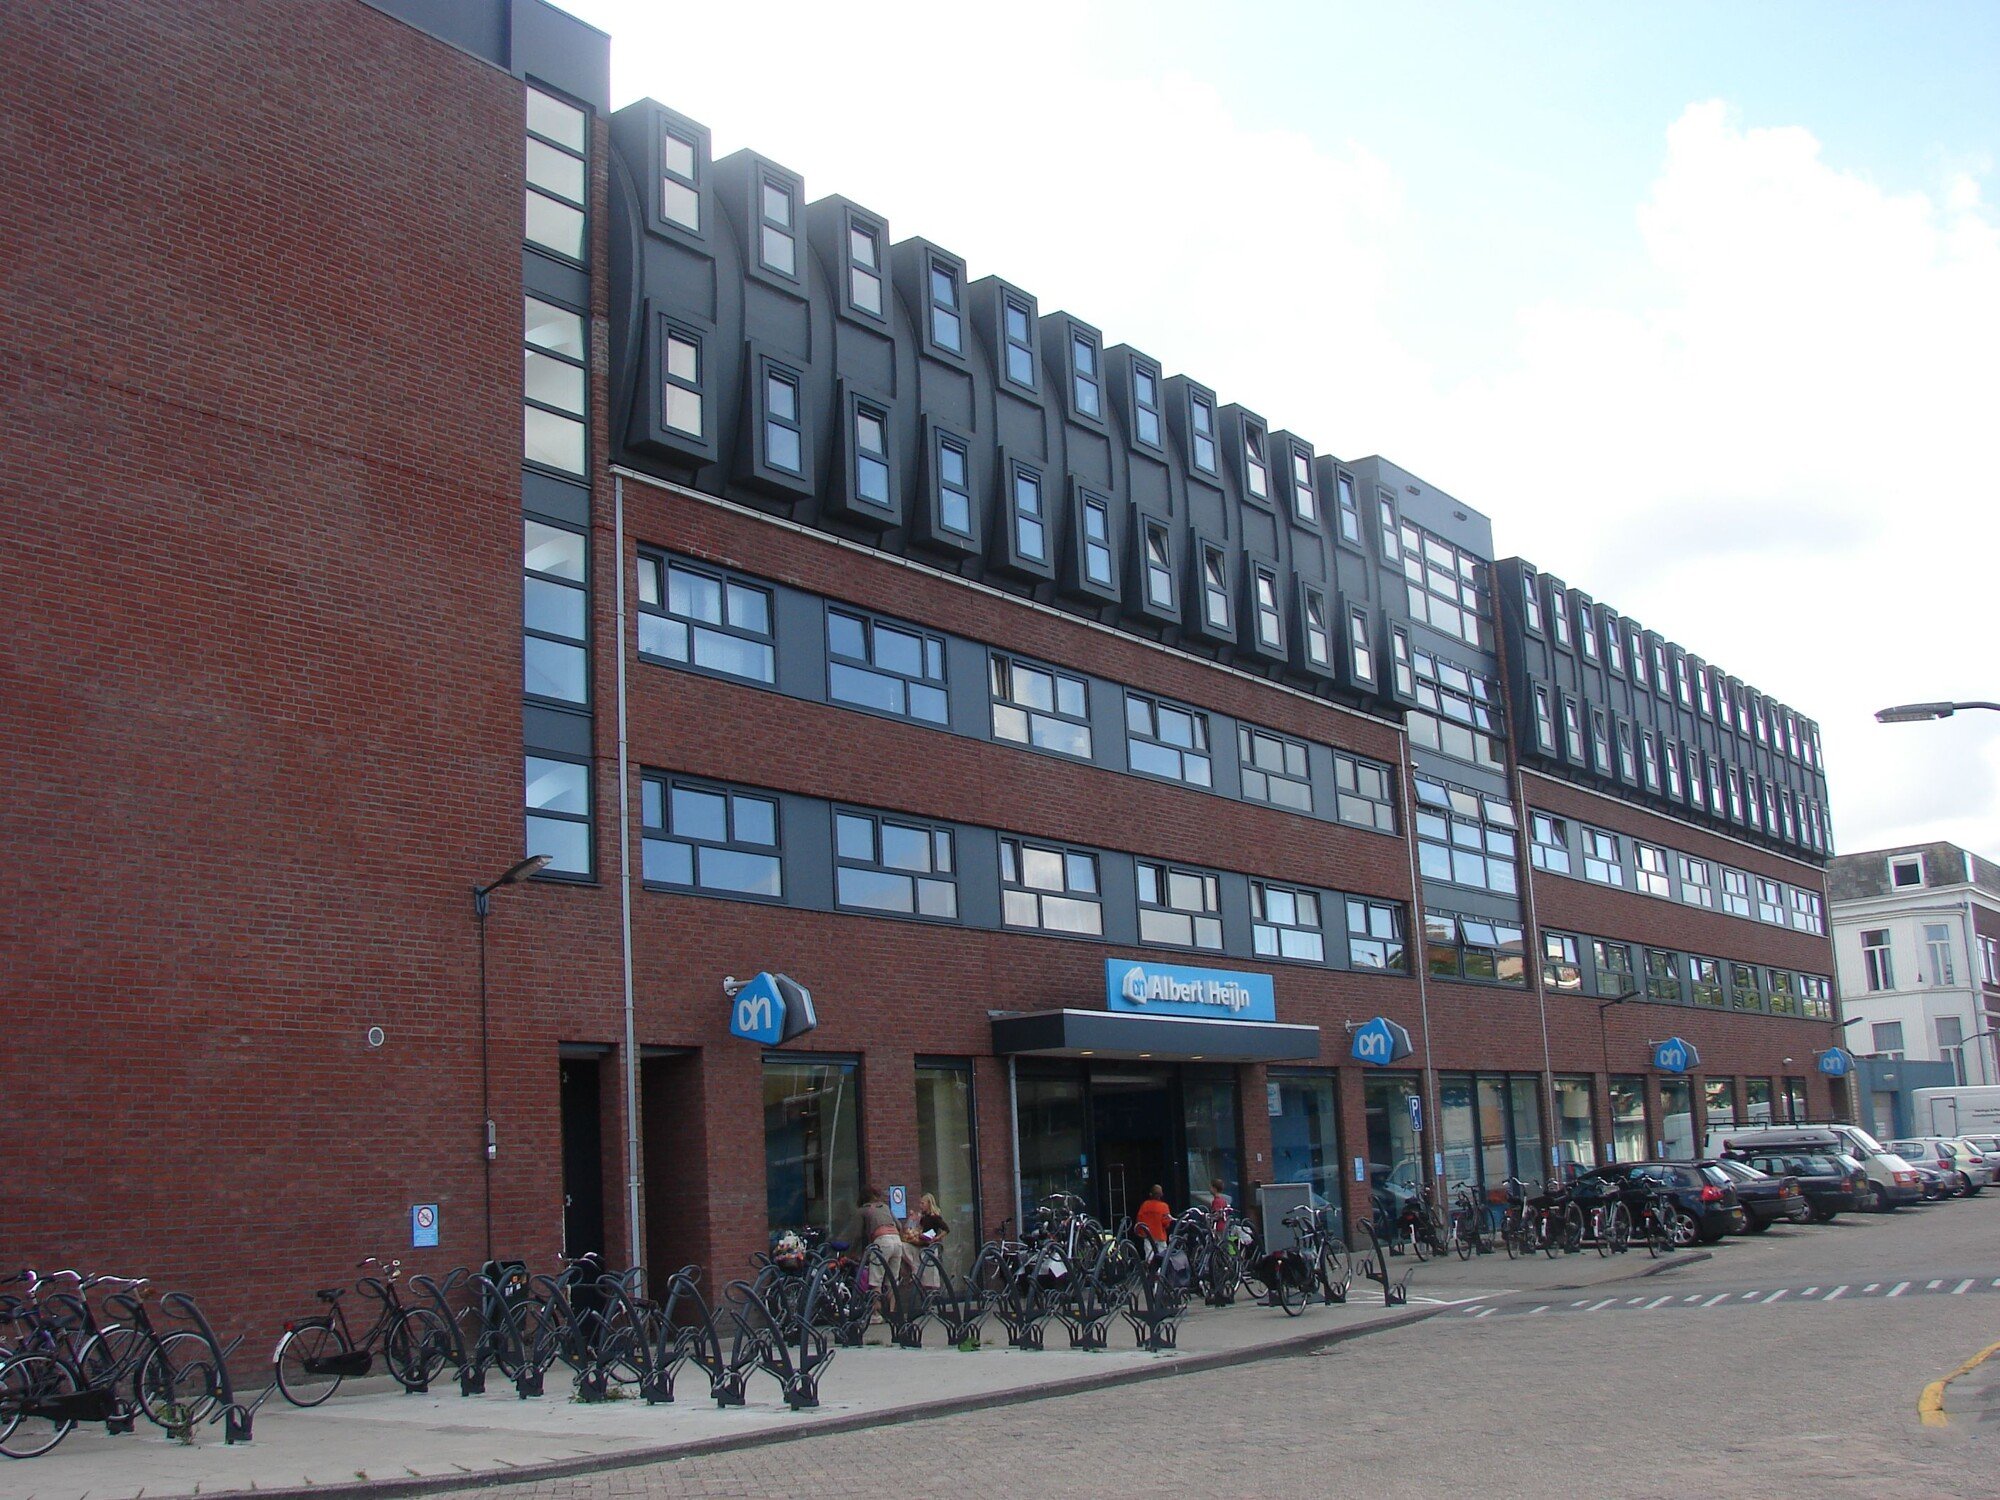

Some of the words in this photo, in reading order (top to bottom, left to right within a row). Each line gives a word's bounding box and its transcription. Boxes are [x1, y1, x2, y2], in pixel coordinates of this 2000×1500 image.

[1149, 975, 1204, 1004] Albert
[1207, 979, 1250, 1013] Heijn
[1411, 1098, 1419, 1117] P
